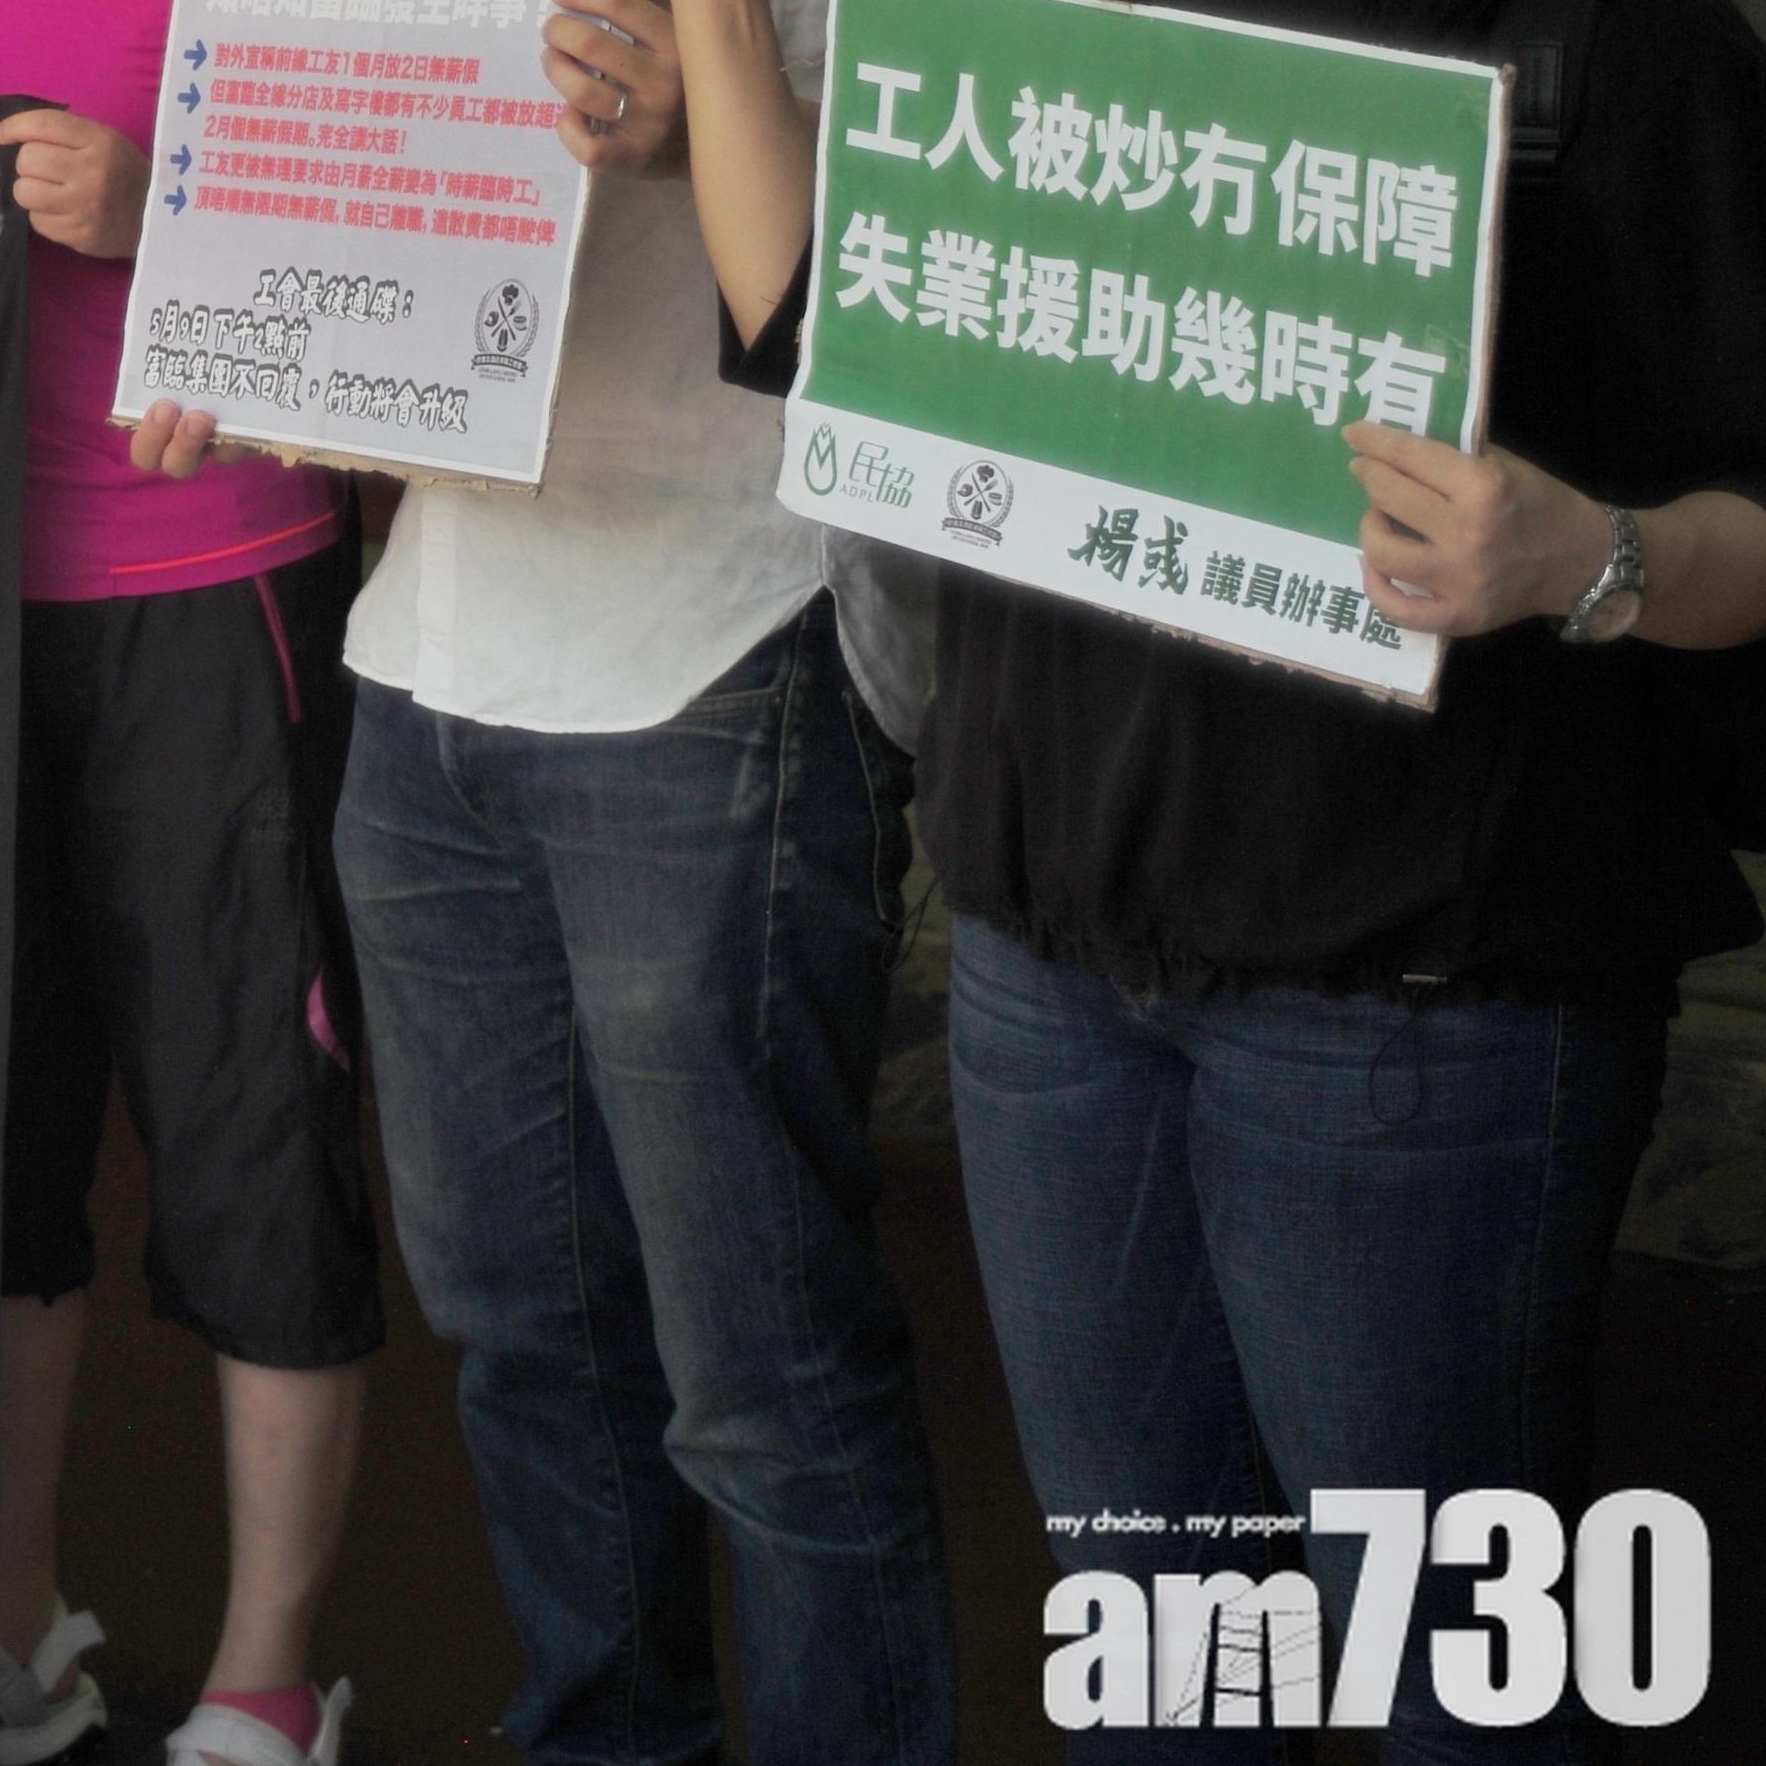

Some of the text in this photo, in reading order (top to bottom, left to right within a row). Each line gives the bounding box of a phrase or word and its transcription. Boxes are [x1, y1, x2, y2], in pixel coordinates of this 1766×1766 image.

[845, 61, 1460, 280] 工人被炒冇保障
[835, 211, 1446, 435] 失業援助幾時有
[849, 440, 915, 509] 民協
[1200, 550, 1403, 651] 議員辦事處
